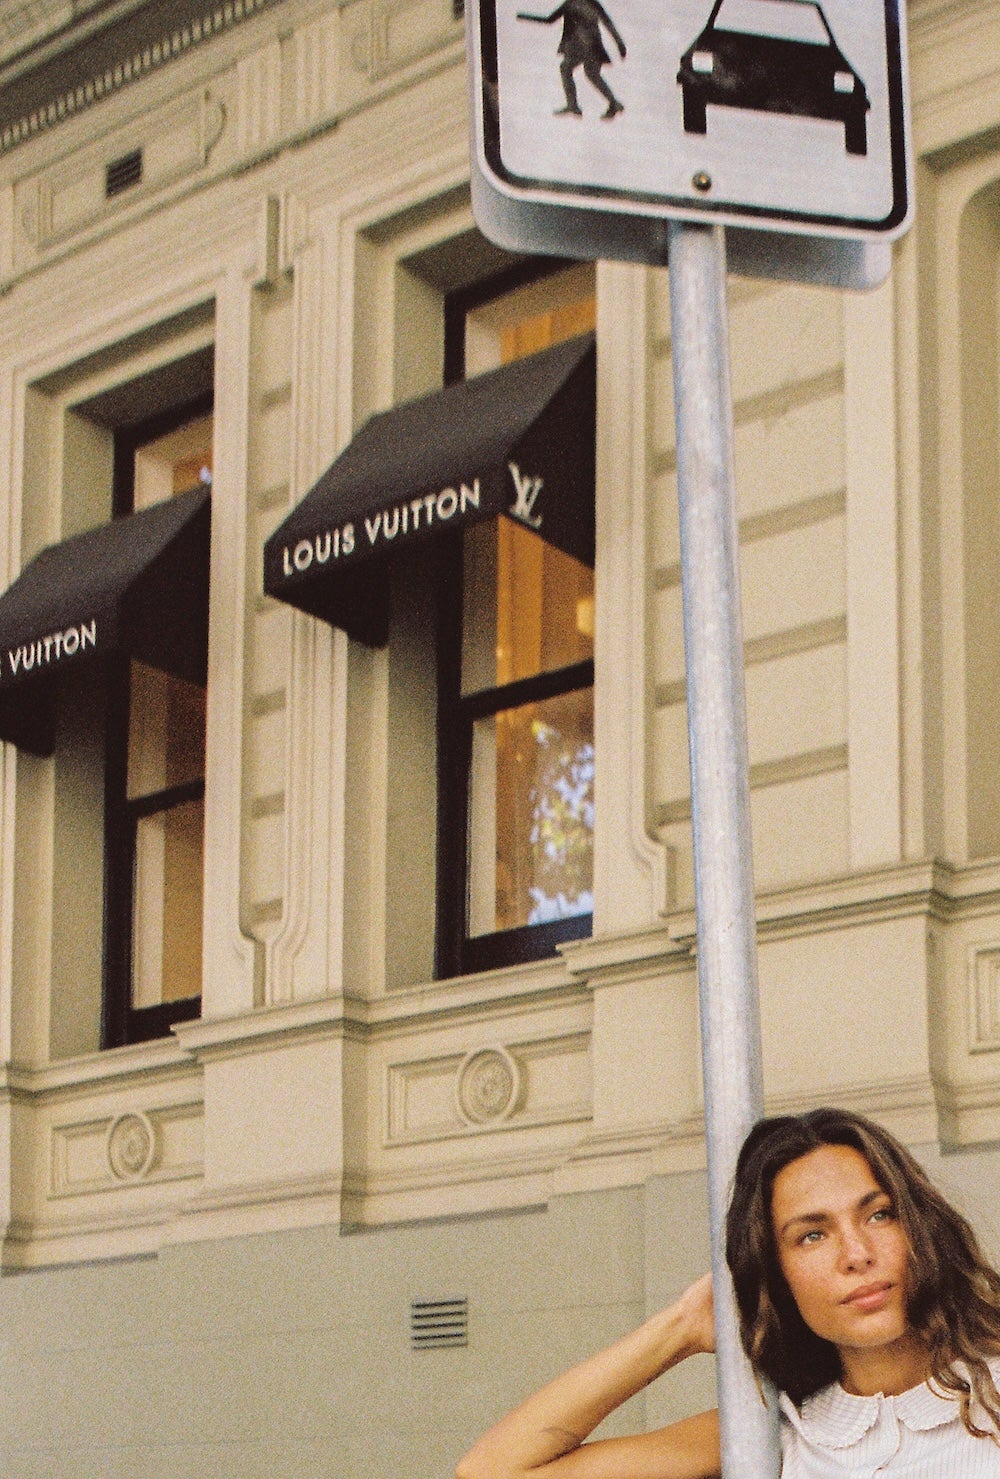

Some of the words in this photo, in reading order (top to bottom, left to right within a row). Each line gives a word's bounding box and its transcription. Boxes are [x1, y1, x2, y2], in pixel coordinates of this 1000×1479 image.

[283, 522, 355, 577] LOUIS
[364, 477, 480, 544] VUITTON
[8, 618, 97, 676] VUITTON
